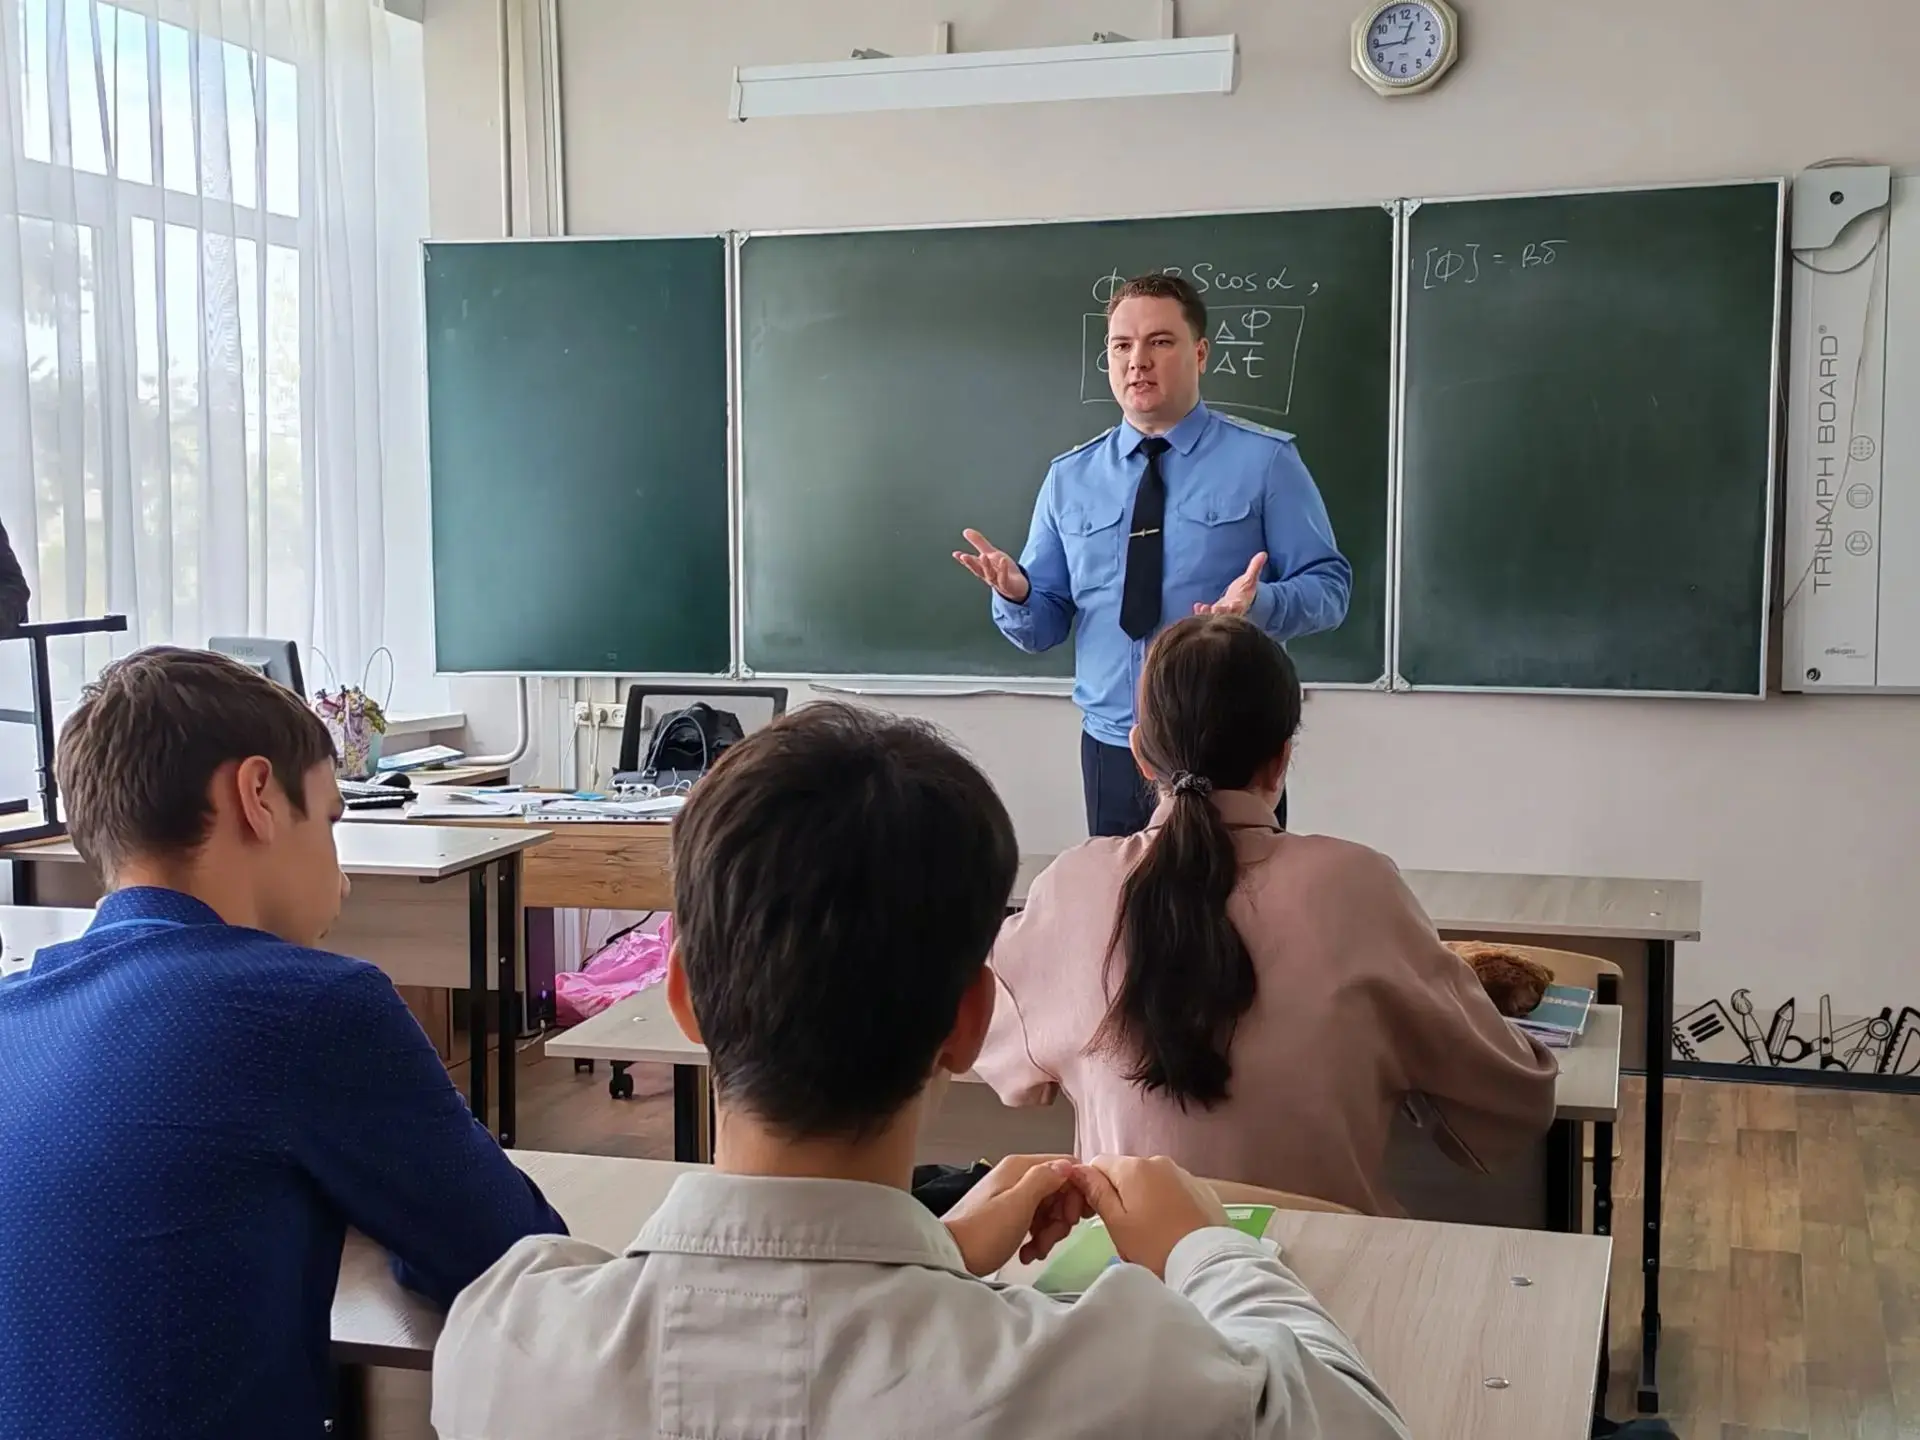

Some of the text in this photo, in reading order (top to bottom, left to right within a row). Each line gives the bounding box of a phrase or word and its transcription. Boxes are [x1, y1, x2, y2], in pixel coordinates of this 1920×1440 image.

[1387, 13, 1396, 24] 11
[1399, 9, 1411, 20] 12
[1416, 12, 1421, 22] 1
[1377, 24, 1388, 35] 10
[1424, 20, 1431, 31] 2
[1373, 38, 1381, 49] 9
[1429, 34, 1436, 45] 3
[1377, 52, 1384, 63] 8
[1425, 48, 1432, 58] 4
[1387, 61, 1394, 73] 7
[1400, 63, 1407, 73] 6
[1416, 58, 1422, 69] 5
[1813, 457, 1835, 595] TRIUMPH
